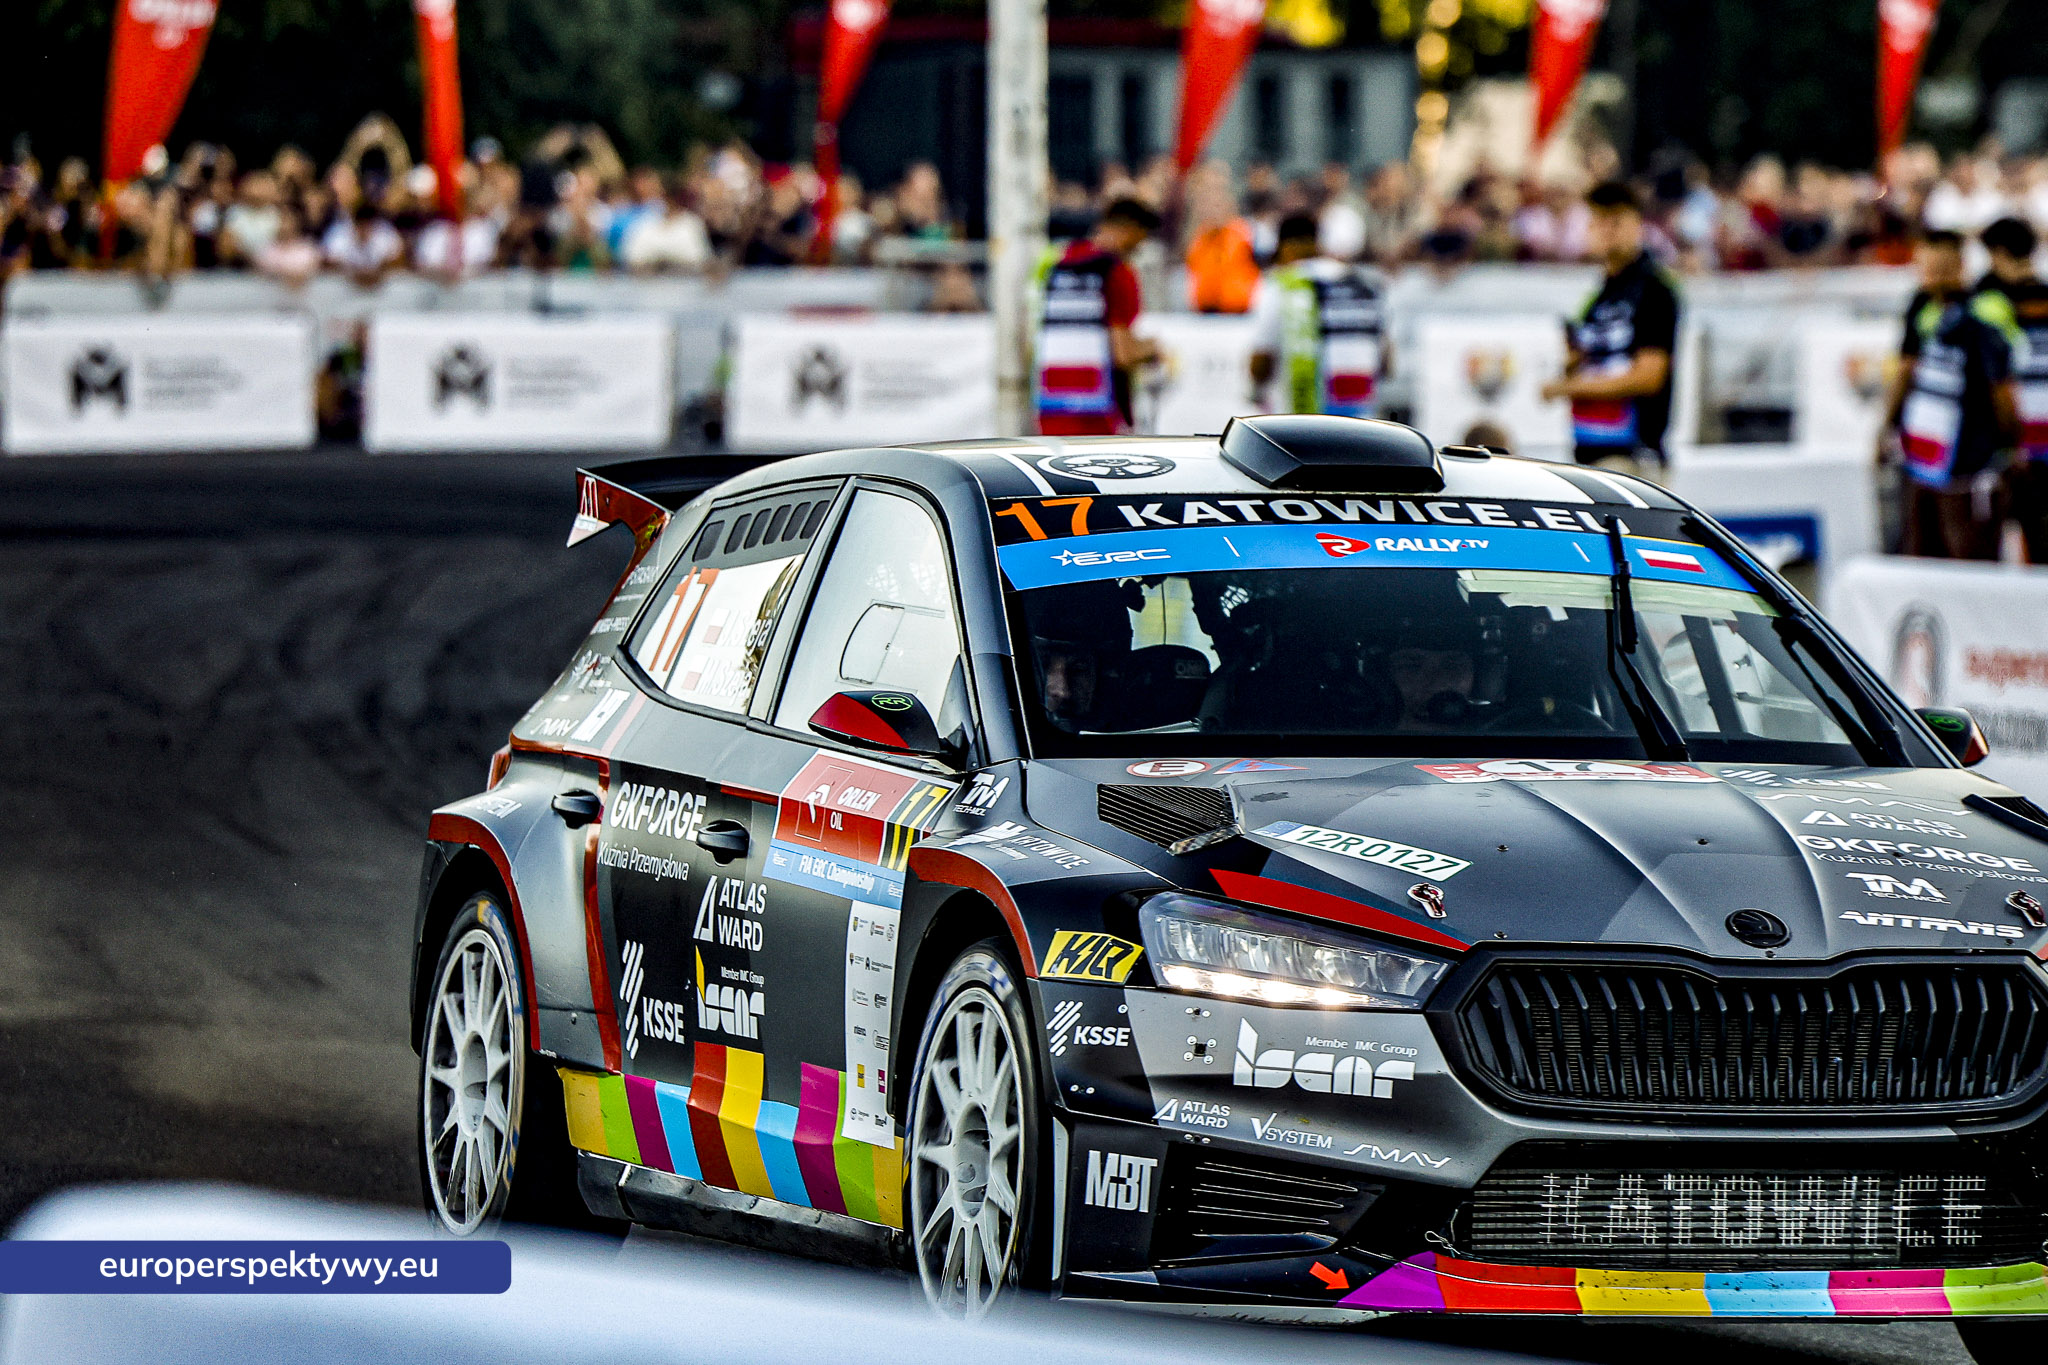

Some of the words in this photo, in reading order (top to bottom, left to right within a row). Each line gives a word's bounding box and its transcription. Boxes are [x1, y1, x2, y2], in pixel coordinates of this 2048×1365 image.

[995, 497, 1094, 541] 17
[1117, 498, 1631, 535] KATOWICE.EU
[650, 565, 720, 672] 17
[1505, 760, 1595, 773] 17
[610, 780, 707, 842] GKFORGE
[837, 786, 882, 812] ORLEN
[829, 811, 844, 831] OIL
[887, 784, 951, 872] 17
[1849, 812, 1957, 831] ATLAS
[1856, 819, 1969, 840] WARD
[597, 841, 630, 870] Kuźnia
[1797, 834, 2041, 874] GKFORGE
[1812, 851, 1894, 868] Kuźnia
[718, 877, 767, 915] ATLAS
[717, 914, 764, 952] WARD
[642, 996, 685, 1045] KSSE
[1073, 1025, 1131, 1047] KSSE
[1354, 1040, 1379, 1052] IMC
[1380, 1043, 1418, 1058] Group
[1180, 1113, 1229, 1130] WARD
[1181, 1101, 1231, 1117] ATLAS
[1540, 1171, 1986, 1246] KATOWICE
